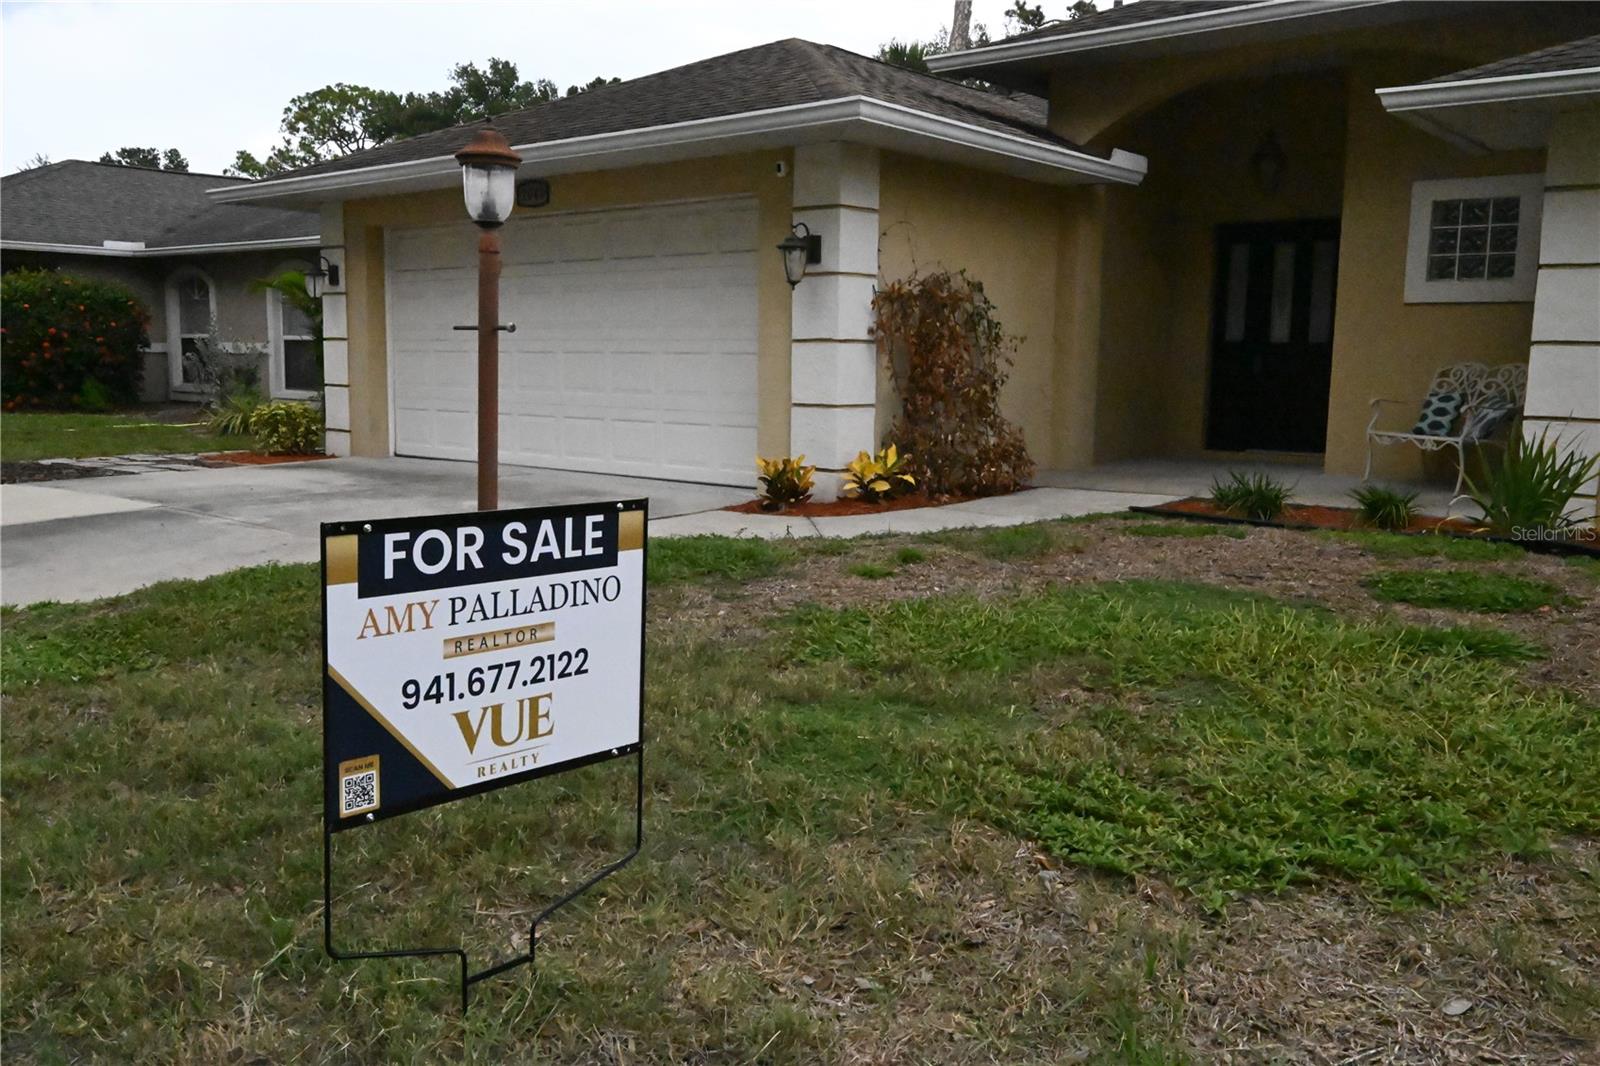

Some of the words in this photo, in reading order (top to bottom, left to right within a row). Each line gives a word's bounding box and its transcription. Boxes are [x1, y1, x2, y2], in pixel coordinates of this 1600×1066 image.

[383, 526, 485, 580] FOR
[501, 514, 605, 566] SALE
[356, 600, 440, 640] AMY
[447, 575, 621, 626] PALLADINO
[454, 628, 538, 653] REALTOR
[401, 648, 589, 710] 941.677.2122
[451, 692, 555, 755] VUE
[477, 752, 540, 778] REALTY
